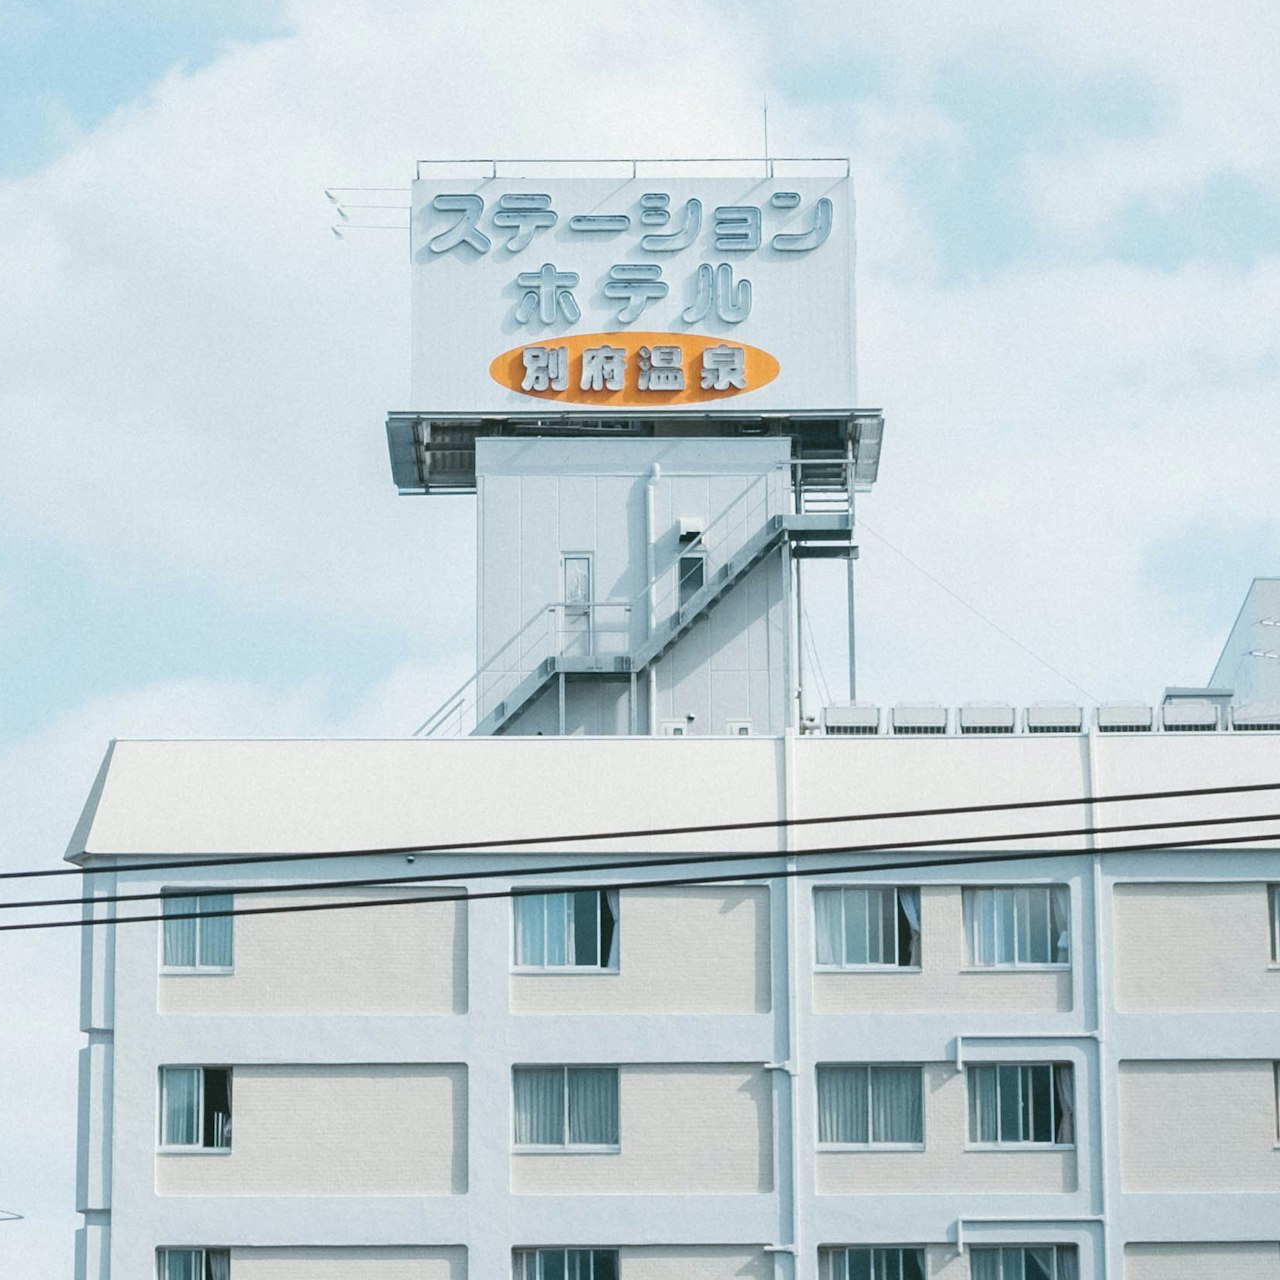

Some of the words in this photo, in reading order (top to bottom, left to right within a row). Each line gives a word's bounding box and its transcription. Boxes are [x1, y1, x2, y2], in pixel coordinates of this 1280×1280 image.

[428, 191, 834, 255] ステーション
[514, 262, 753, 325] ホテル
[520, 344, 748, 392] 別府温泉
